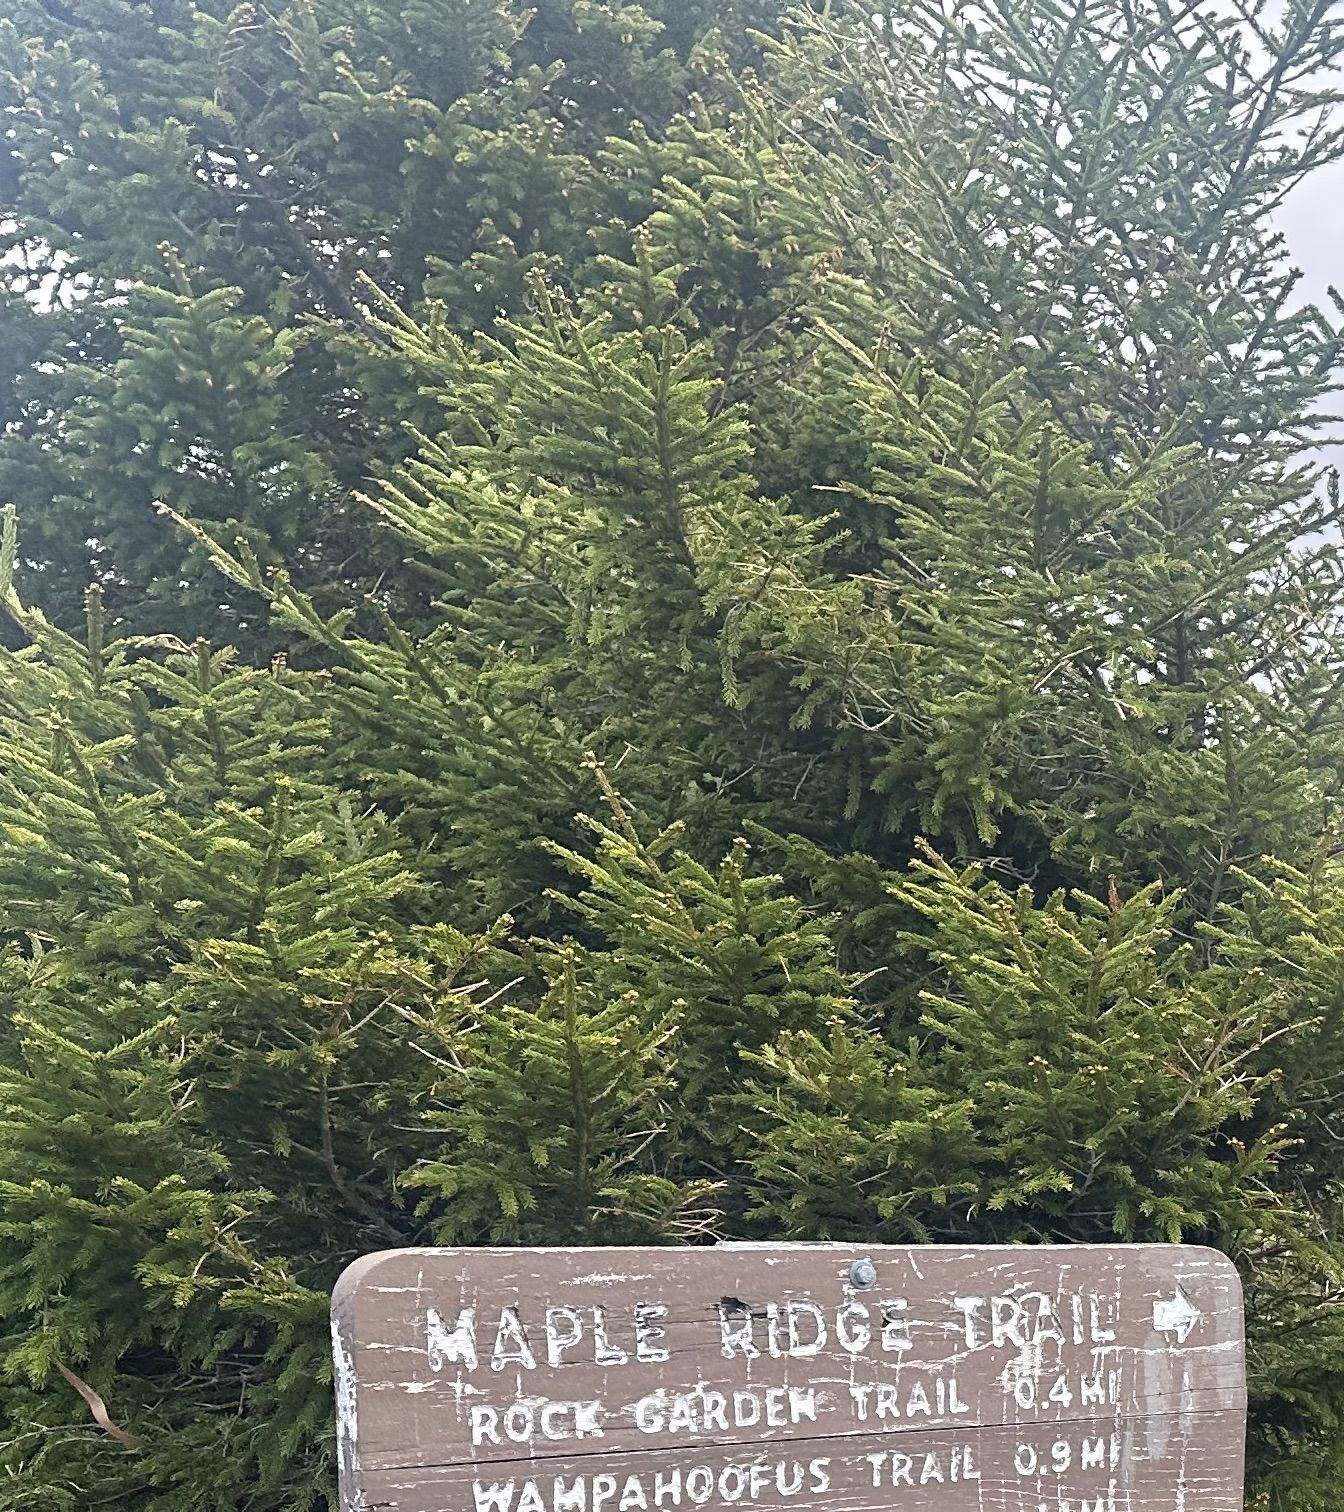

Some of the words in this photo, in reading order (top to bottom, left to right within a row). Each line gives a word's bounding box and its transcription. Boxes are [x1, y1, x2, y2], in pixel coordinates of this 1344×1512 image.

[425, 1302, 670, 1372] MAPLE
[718, 1297, 913, 1357] RIDGE
[954, 1293, 1117, 1347] TRAIL
[470, 1401, 605, 1446] ROCK
[636, 1385, 817, 1434] GARDEN
[850, 1377, 970, 1420] TRAIL
[1013, 1372, 1073, 1410] 0.4
[1080, 1369, 1117, 1405] MI
[866, 1445, 981, 1487] TRAIL
[1013, 1440, 1072, 1476] 0.9
[1081, 1434, 1119, 1470] MI
